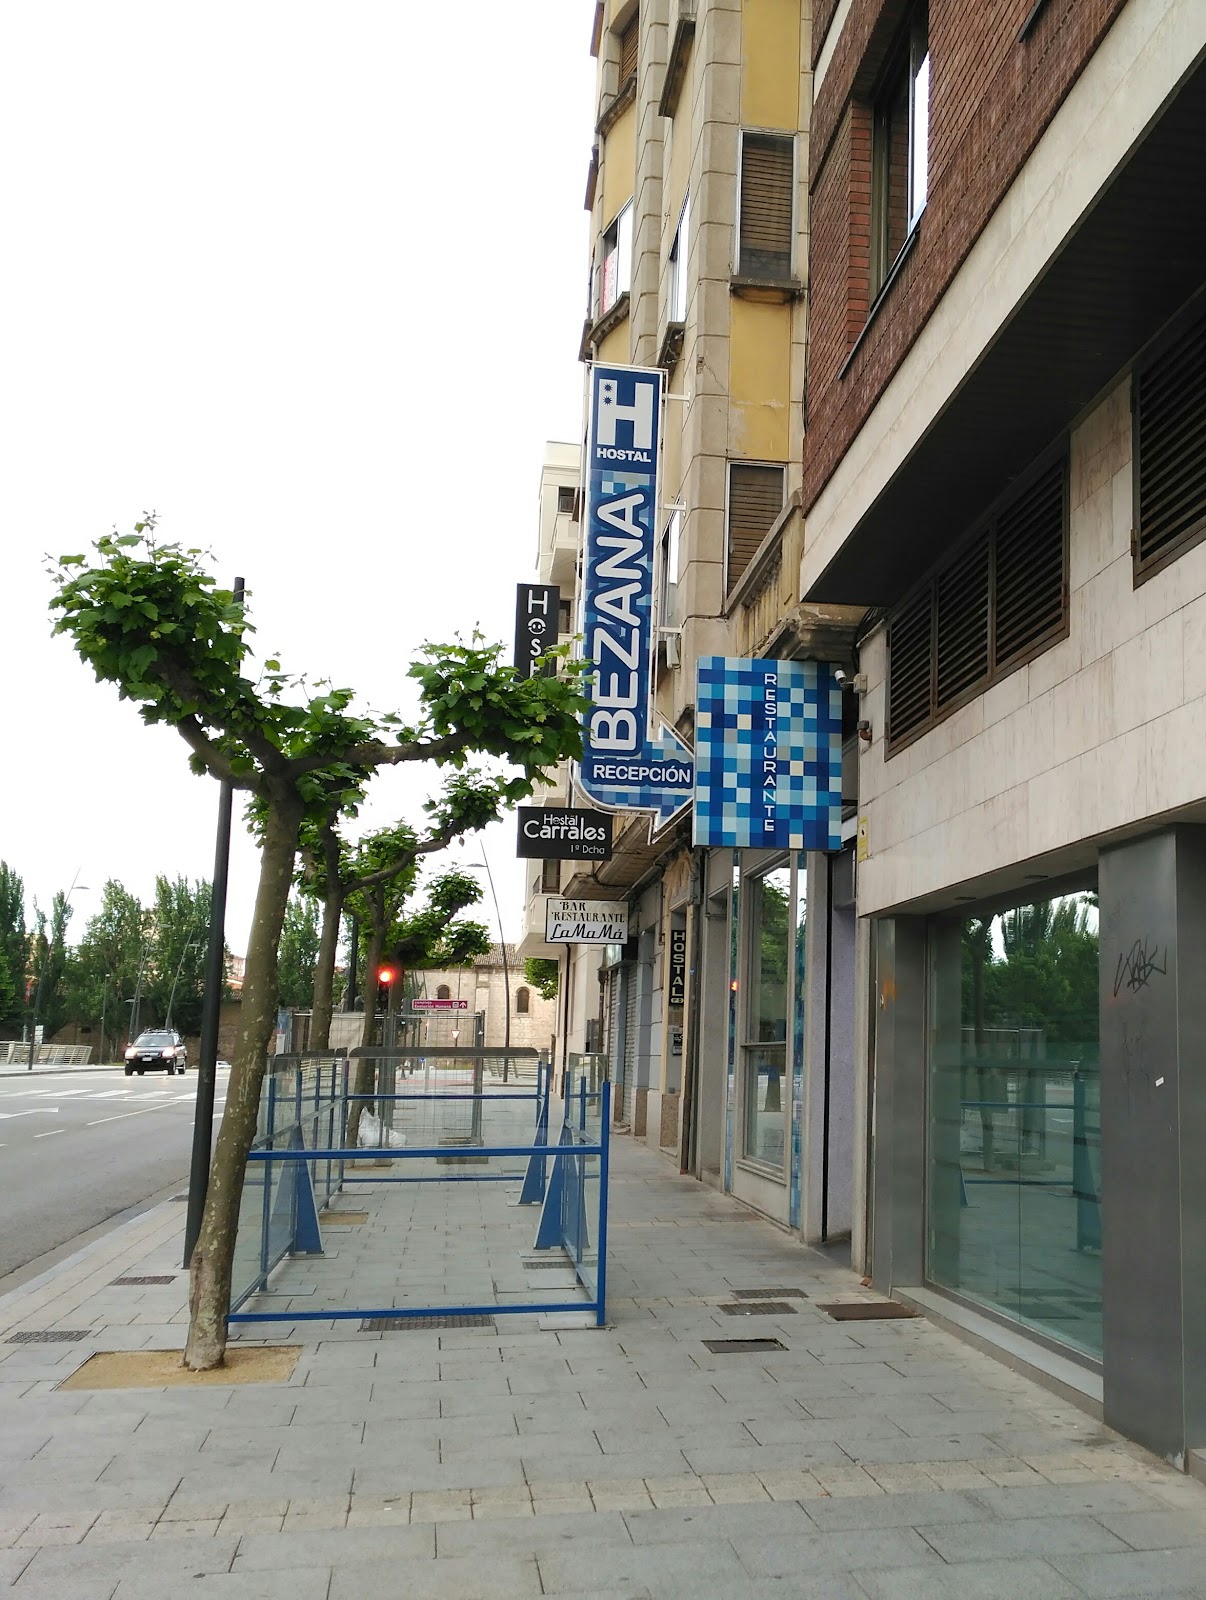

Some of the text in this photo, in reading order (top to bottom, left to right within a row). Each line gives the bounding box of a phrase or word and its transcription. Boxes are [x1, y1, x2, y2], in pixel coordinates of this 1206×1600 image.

[597, 379, 653, 449] H
[596, 447, 652, 463] HOSTAL
[590, 493, 645, 751] BEZANA
[763, 673, 777, 832] RESTAURANTE
[593, 764, 691, 783] RECEPCIÓN
[523, 817, 606, 841] Carrales
[582, 845, 605, 854] Dcha
[560, 901, 586, 911] BAR
[552, 911, 625, 923] RESTAURANTE
[671, 931, 686, 997] HOSTAL
